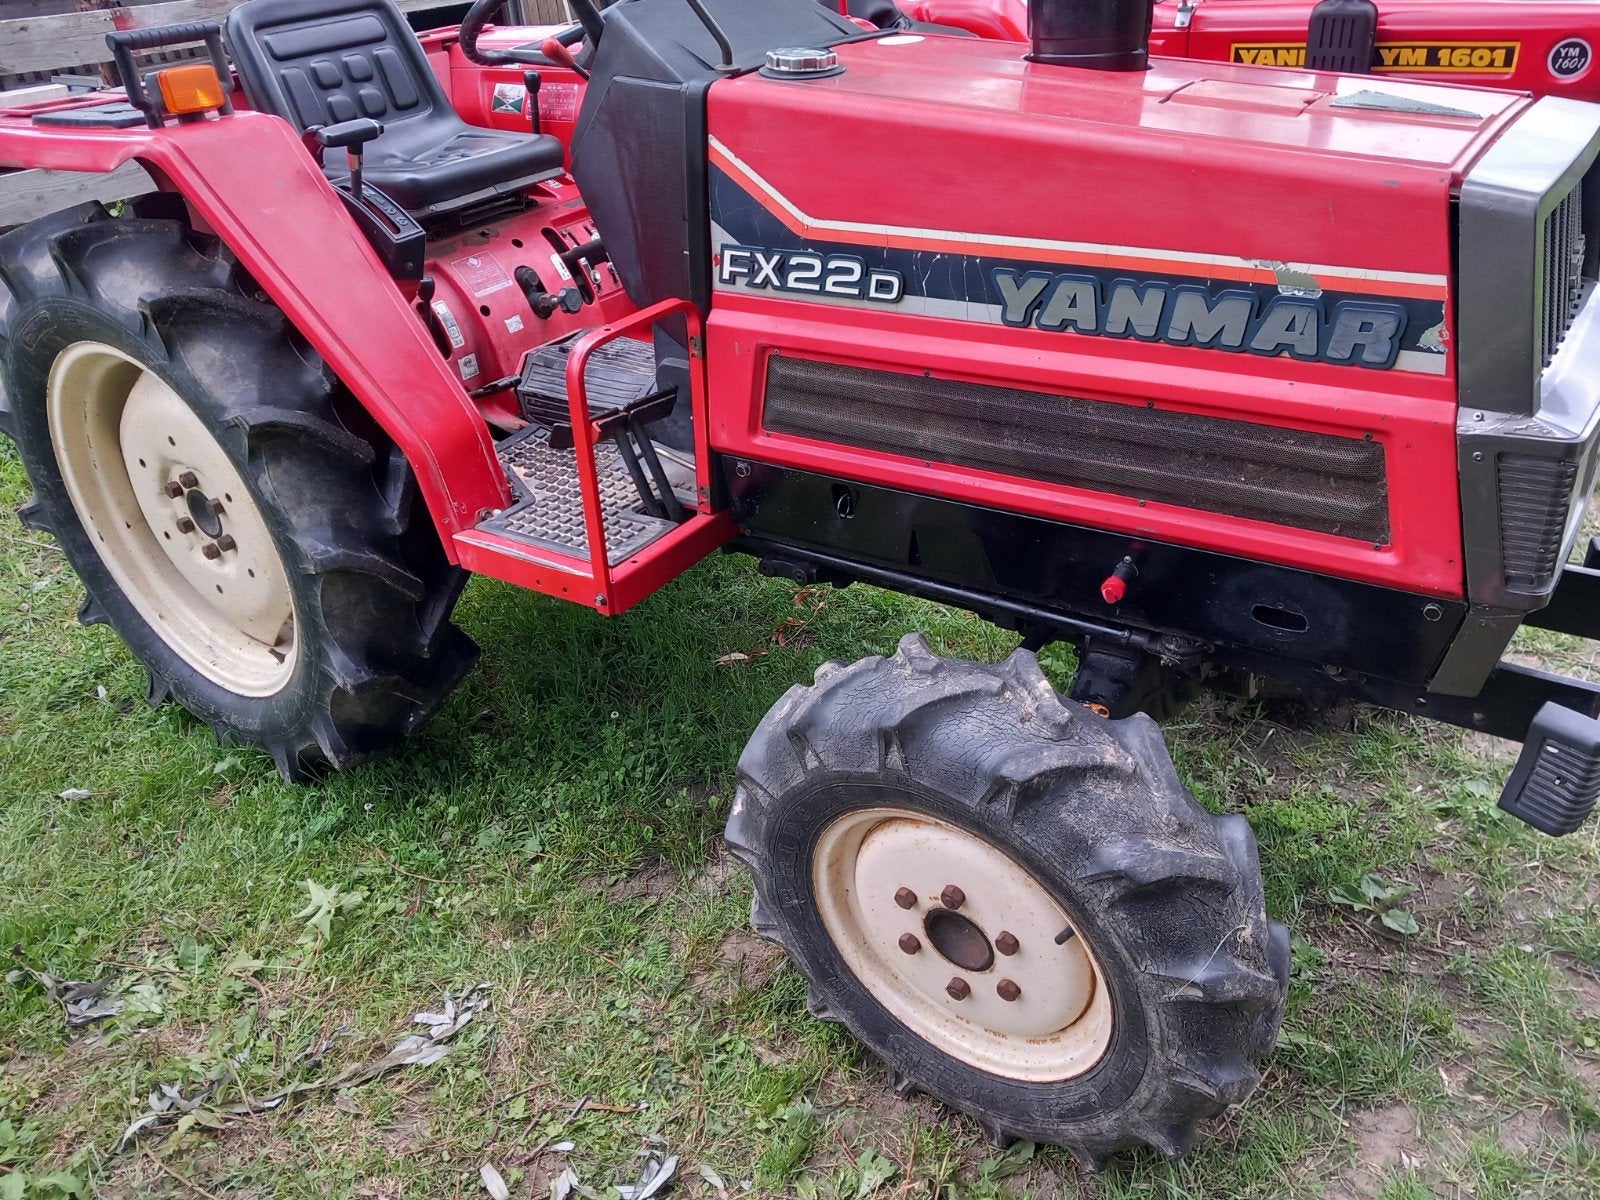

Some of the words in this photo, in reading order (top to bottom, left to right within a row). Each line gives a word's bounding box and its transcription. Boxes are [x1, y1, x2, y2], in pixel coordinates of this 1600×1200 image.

[1379, 48, 1427, 66] YM
[1437, 48, 1506, 67] 1601
[1560, 47, 1580, 58] YM
[1555, 56, 1586, 70] 1601
[721, 247, 902, 302] FX22D
[995, 273, 1397, 364] YANMAR
